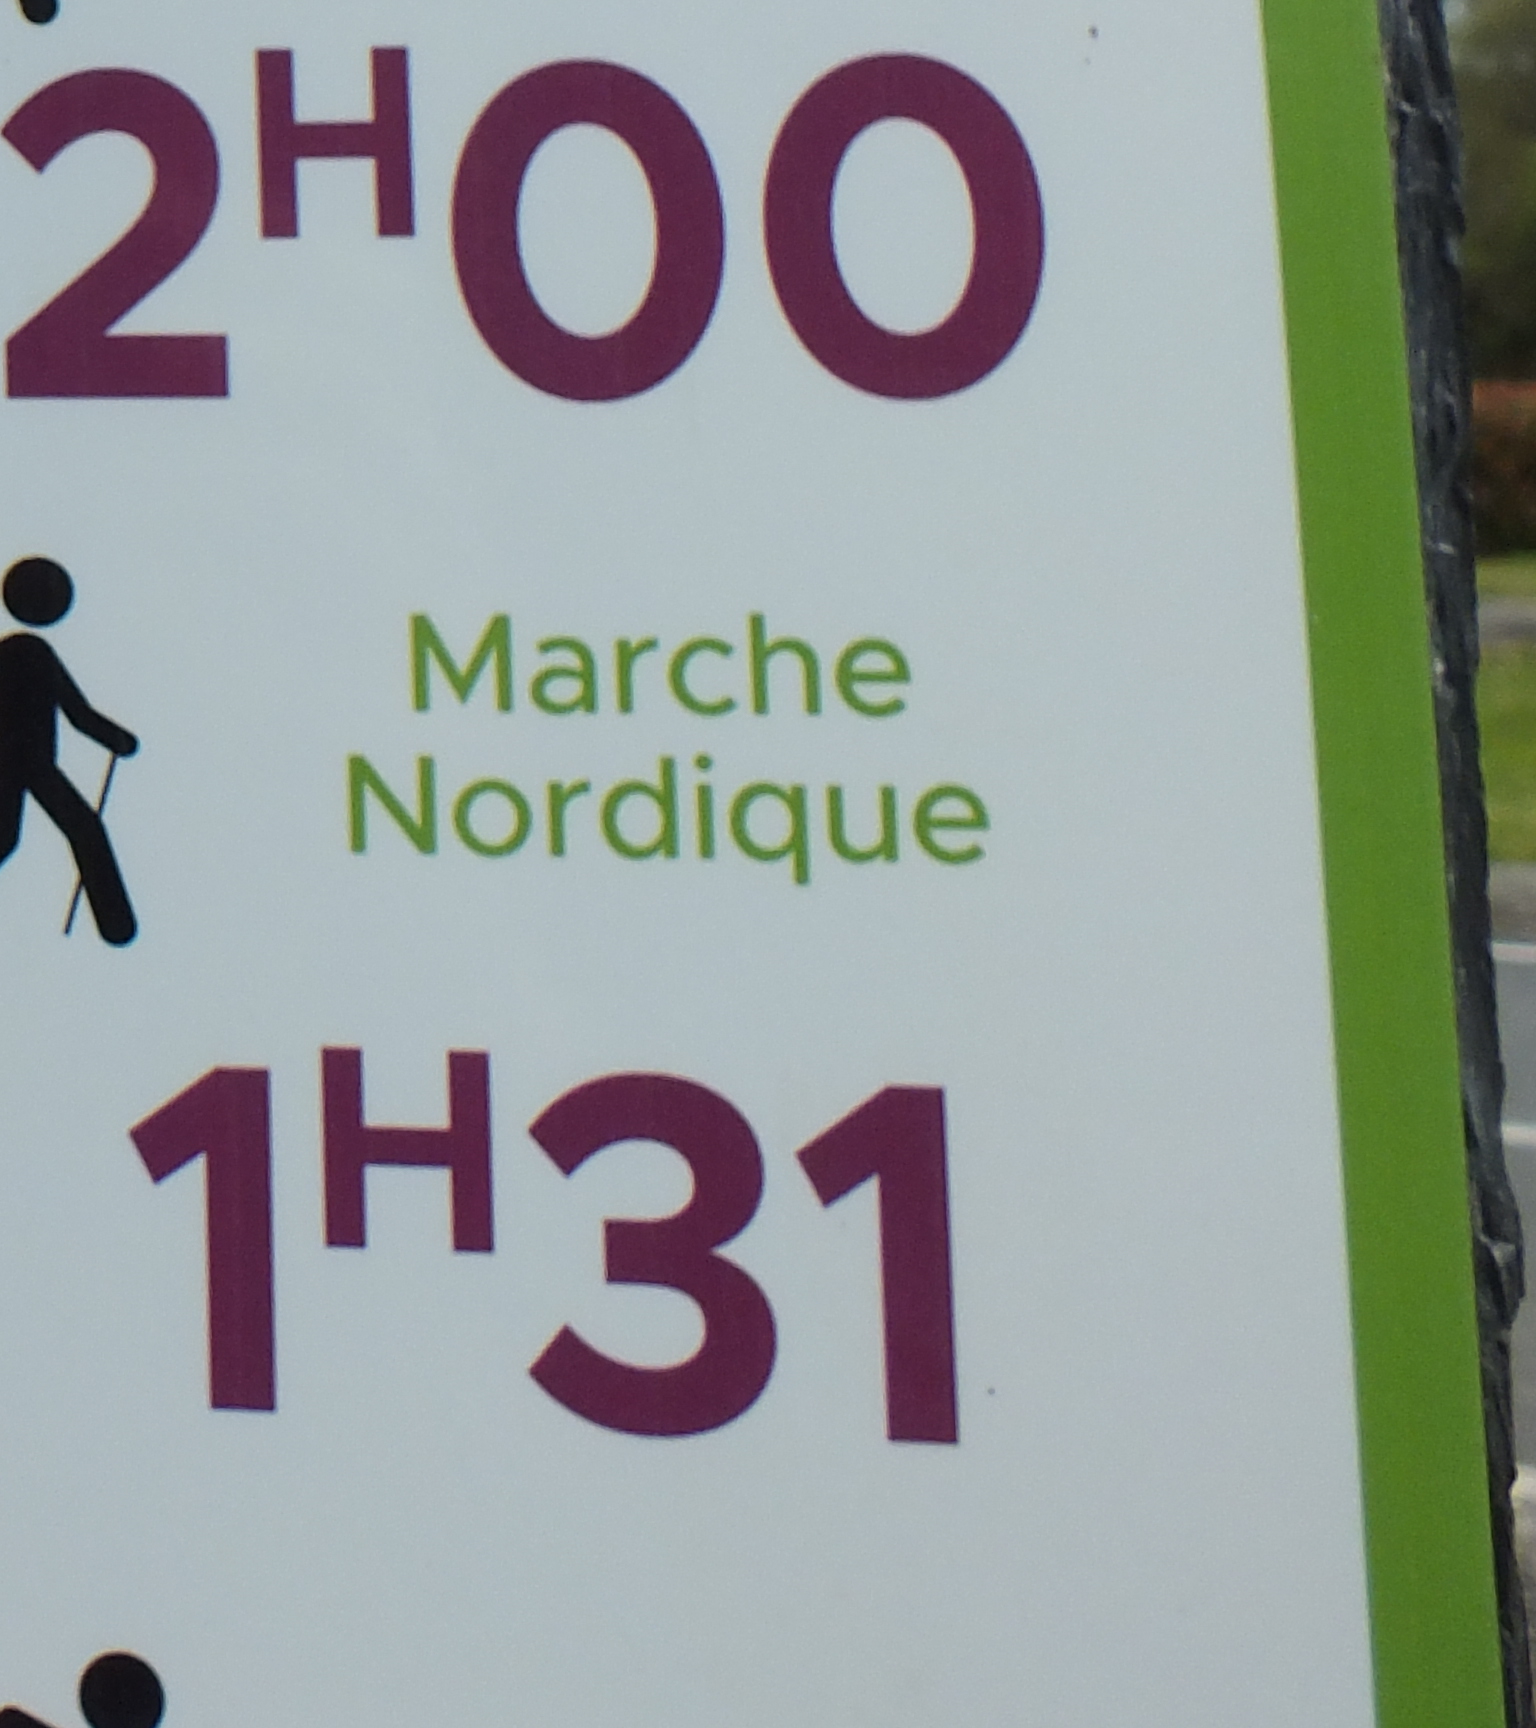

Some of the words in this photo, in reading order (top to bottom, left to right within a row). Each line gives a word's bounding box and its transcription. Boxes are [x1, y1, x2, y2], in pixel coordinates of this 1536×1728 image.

[1, 49, 1046, 402] 2H00
[408, 613, 910, 716] Marche
[346, 748, 989, 885] Nordique
[130, 1048, 958, 1446] 1H31
